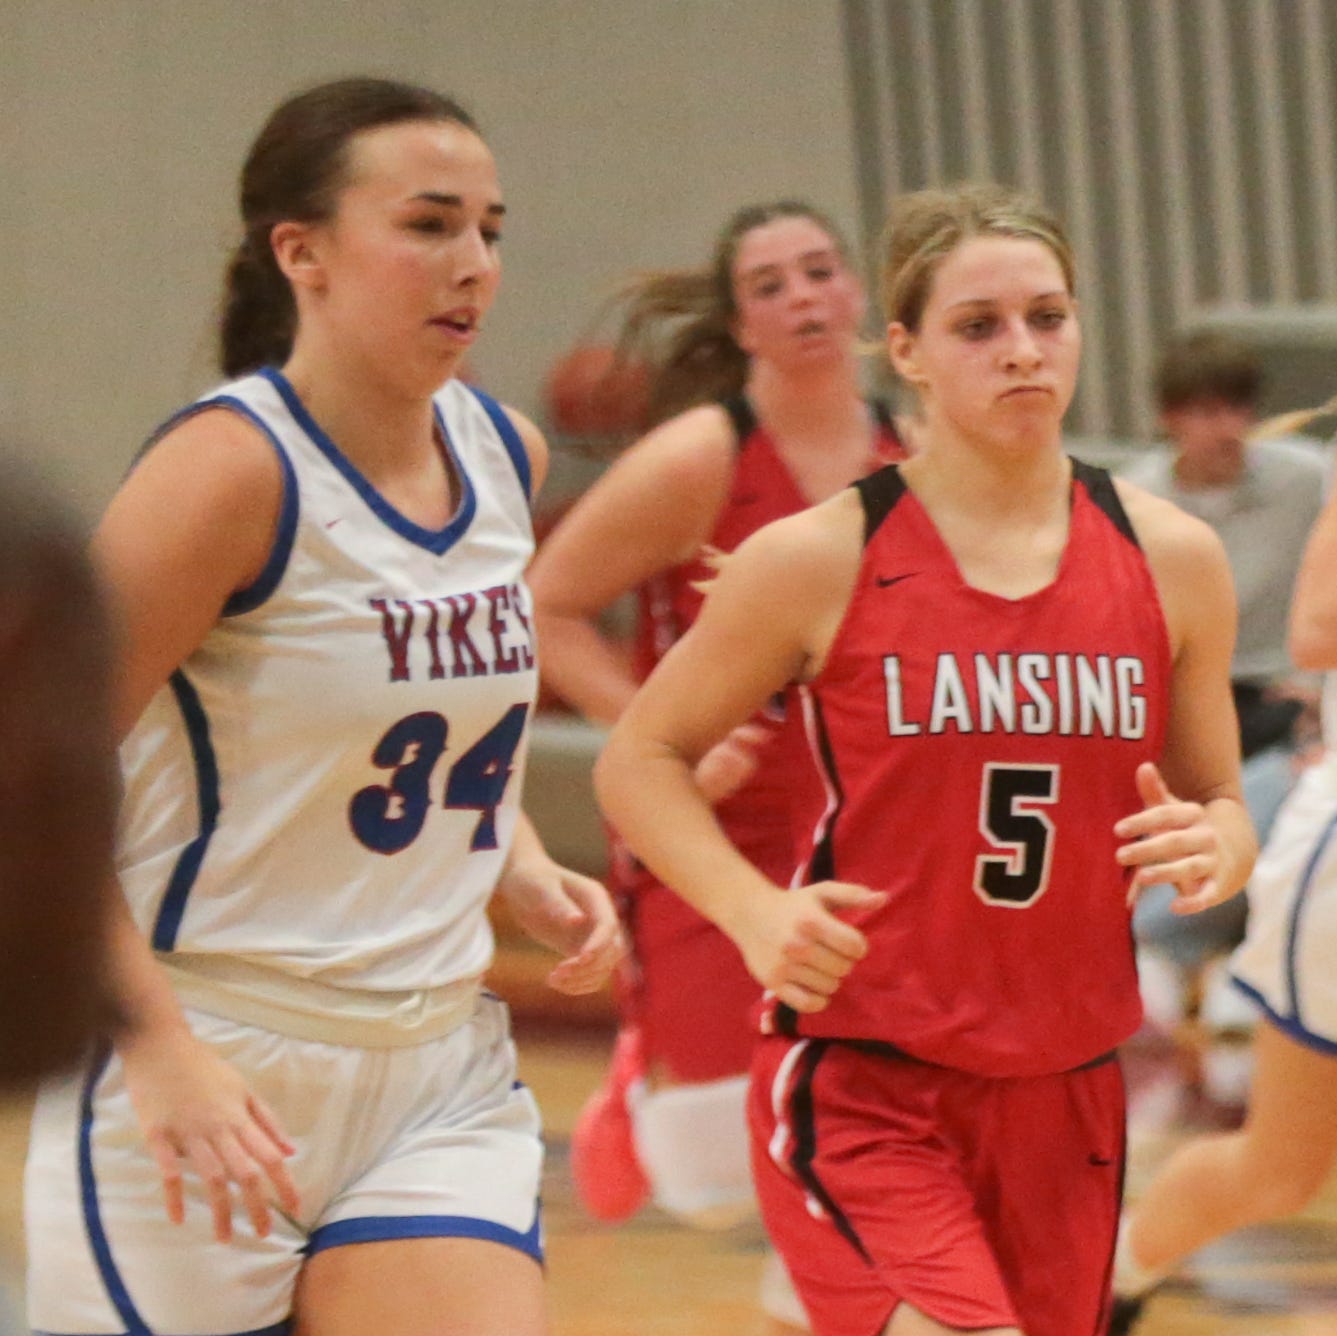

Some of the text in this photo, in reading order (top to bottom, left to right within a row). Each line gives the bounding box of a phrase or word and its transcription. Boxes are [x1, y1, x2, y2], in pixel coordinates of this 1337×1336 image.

[369, 583, 534, 681] VIKES
[883, 653, 1148, 740] LANSING
[348, 702, 530, 855] 34
[972, 761, 1061, 909] 5
